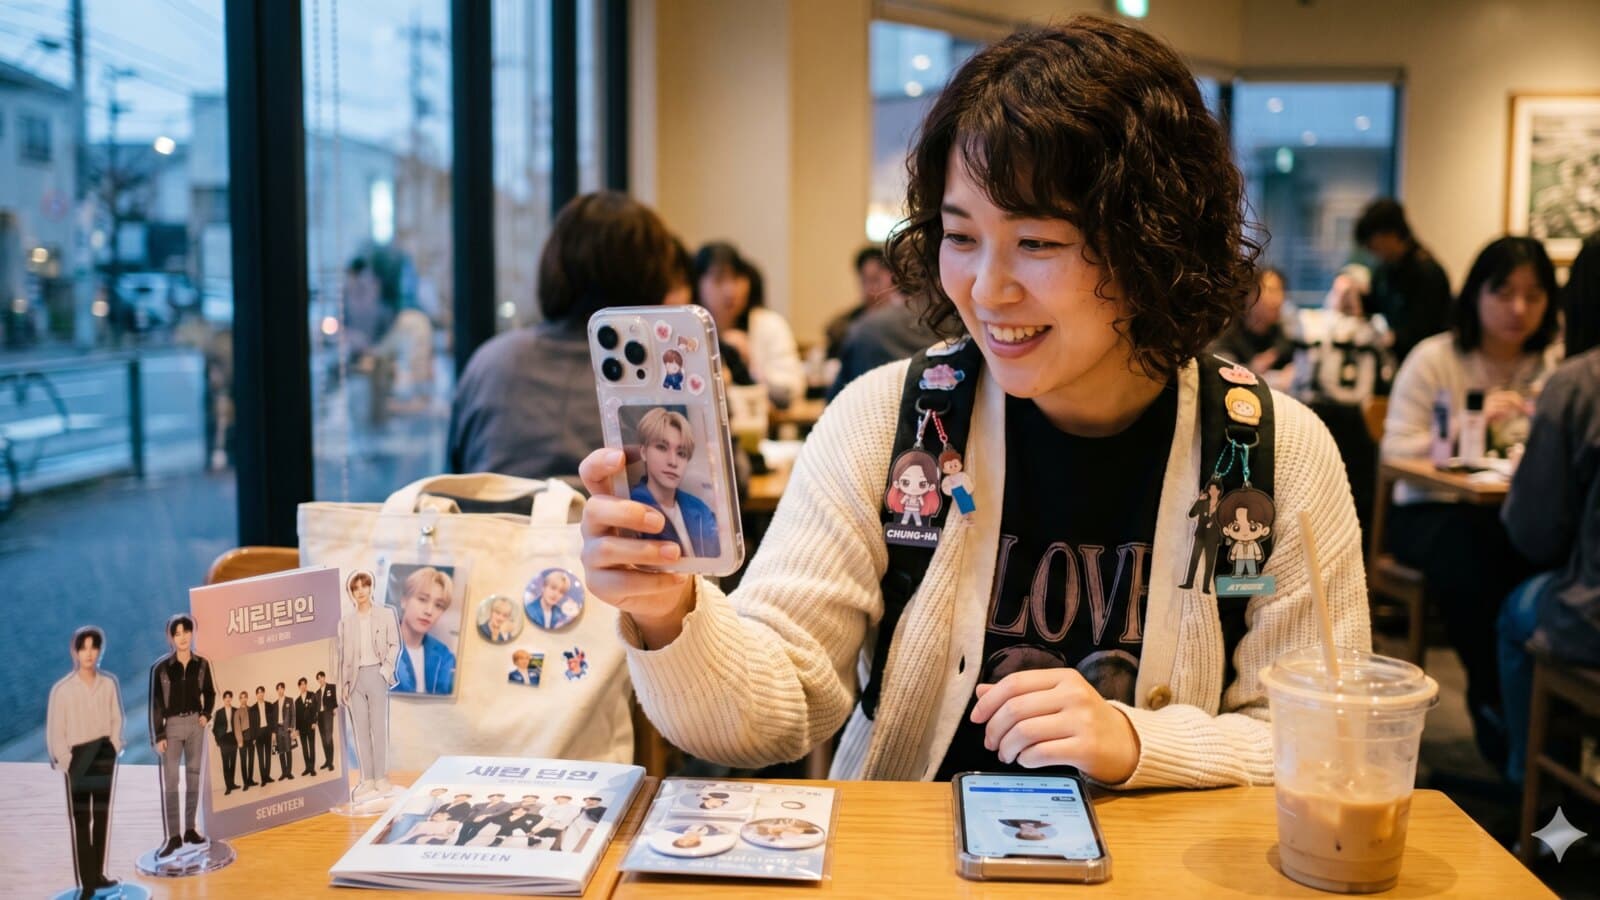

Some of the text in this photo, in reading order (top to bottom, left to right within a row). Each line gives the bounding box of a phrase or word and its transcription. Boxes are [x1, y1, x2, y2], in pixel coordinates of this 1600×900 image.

[886, 529, 938, 541] CHUNG-HA
[255, 796, 305, 820] SEVENTEEN
[421, 850, 512, 862] SEVENTEEN
